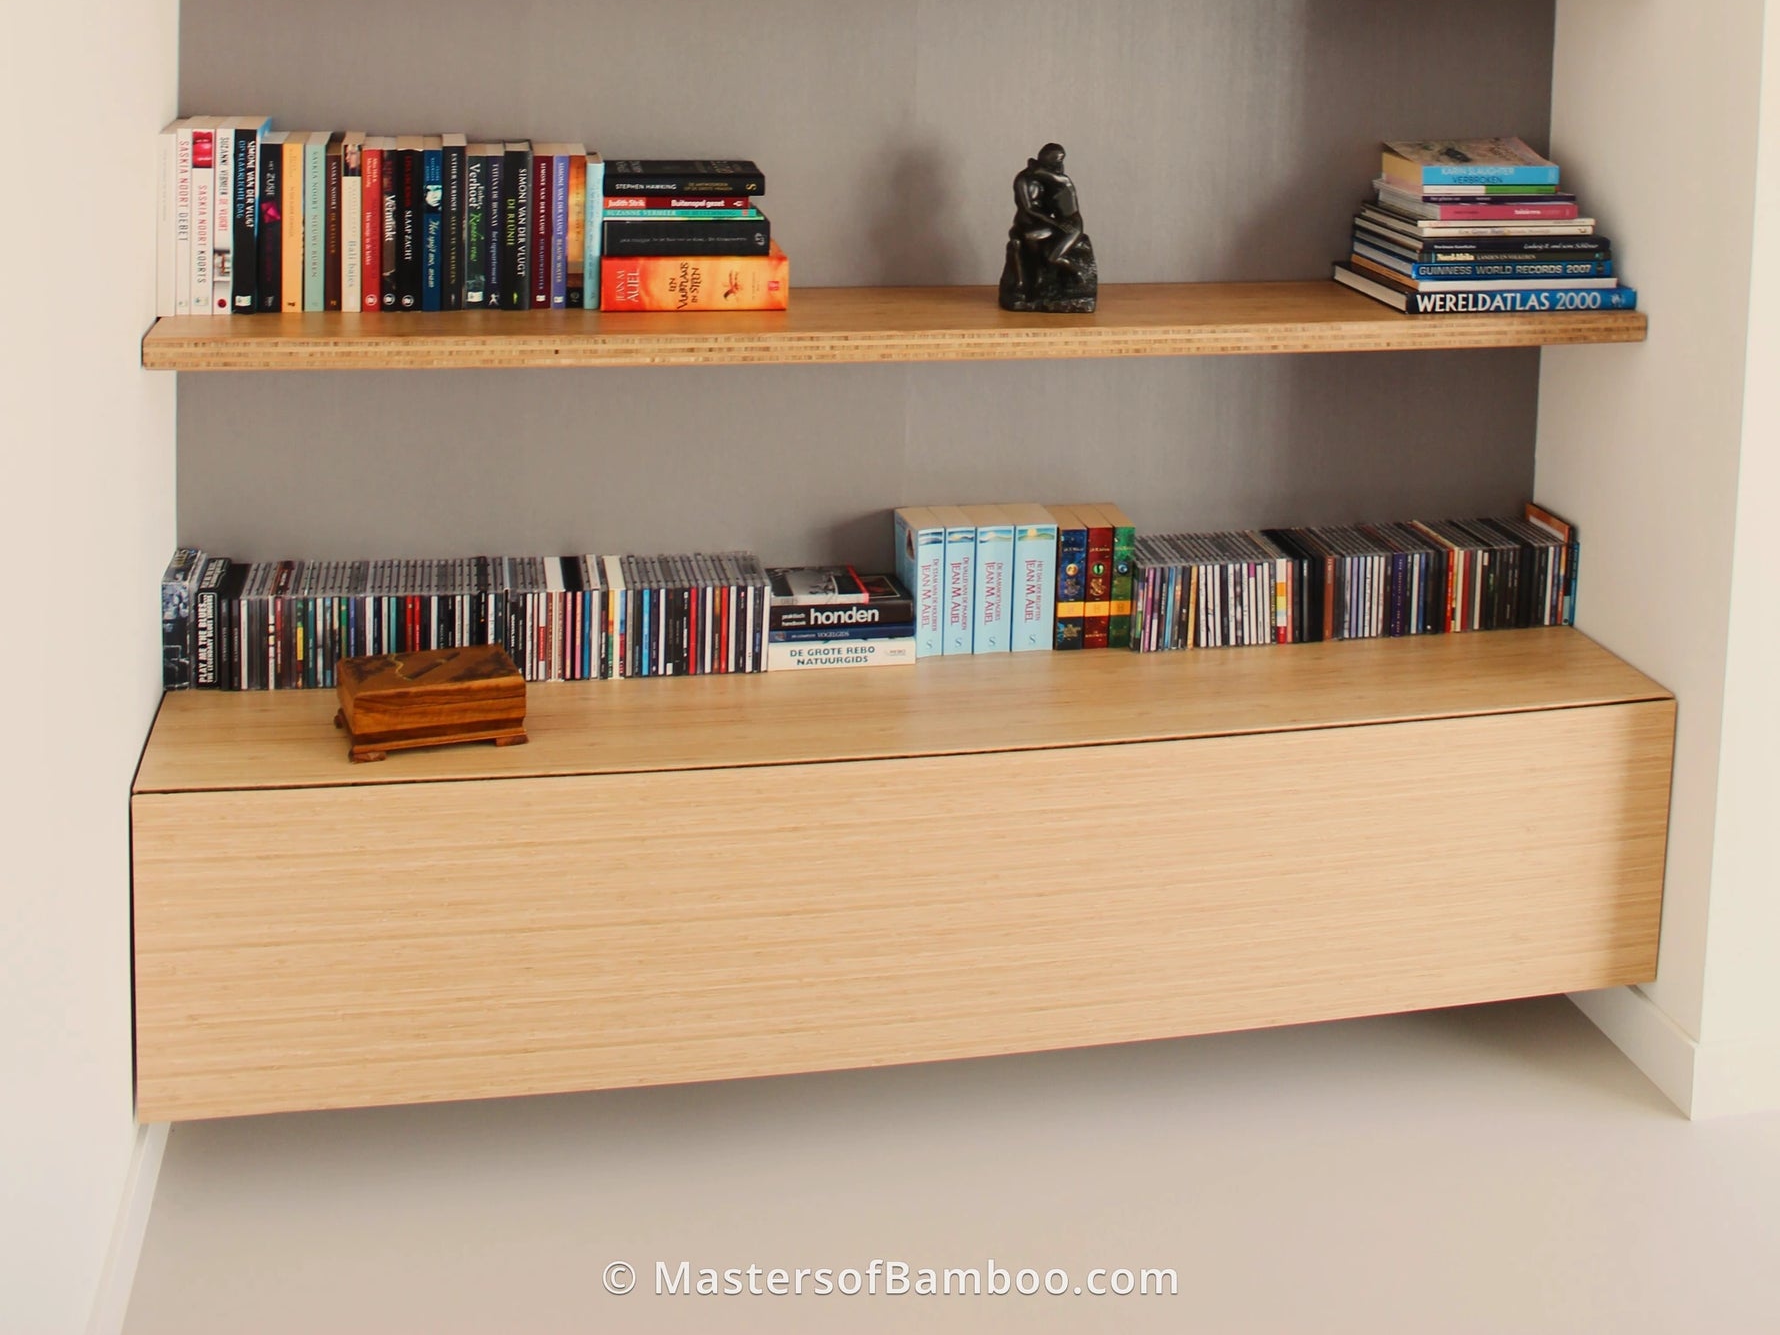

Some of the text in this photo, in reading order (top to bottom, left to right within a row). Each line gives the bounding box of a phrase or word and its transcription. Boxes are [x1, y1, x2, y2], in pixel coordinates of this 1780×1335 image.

[247, 139, 255, 168] SIMONE
[178, 140, 189, 242] SASKIA NOORT DEBET
[266, 172, 275, 198] ZUSJE
[469, 163, 480, 210] Verhoef
[615, 183, 677, 191] STEPHEN HAWKING
[1452, 176, 1503, 184] VERBROKEN
[246, 188, 254, 203] DER
[507, 198, 515, 209] DE
[608, 199, 646, 208] Judith Strik
[198, 184, 207, 284] SASKIA NOORT KOORTS
[517, 168, 527, 278] SIMONE VAN DER VLUGT
[1419, 265, 1592, 276] GUINNESS WORLD RECORDS 2007
[615, 269, 626, 302] JEAN M
[626, 267, 641, 303] AUEL
[1416, 292, 1601, 312] WERELDATLAS 2000
[922, 564, 932, 587] JEAN
[951, 562, 961, 585] JEAN
[985, 561, 996, 584] JEAN
[1025, 560, 1036, 582] JEAN
[810, 606, 880, 626] honden
[922, 604, 931, 629] AUEL
[951, 601, 961, 626] AUEL
[985, 600, 994, 625] AUEL
[1025, 598, 1034, 623] AUEL
[198, 629, 207, 645] THE
[198, 647, 207, 661] ME
[790, 648, 803, 658] DE
[807, 647, 842, 658] GROTE
[846, 645, 876, 656] REBO
[796, 655, 869, 666] NATUURGIDS
[198, 662, 208, 683] PLAY
